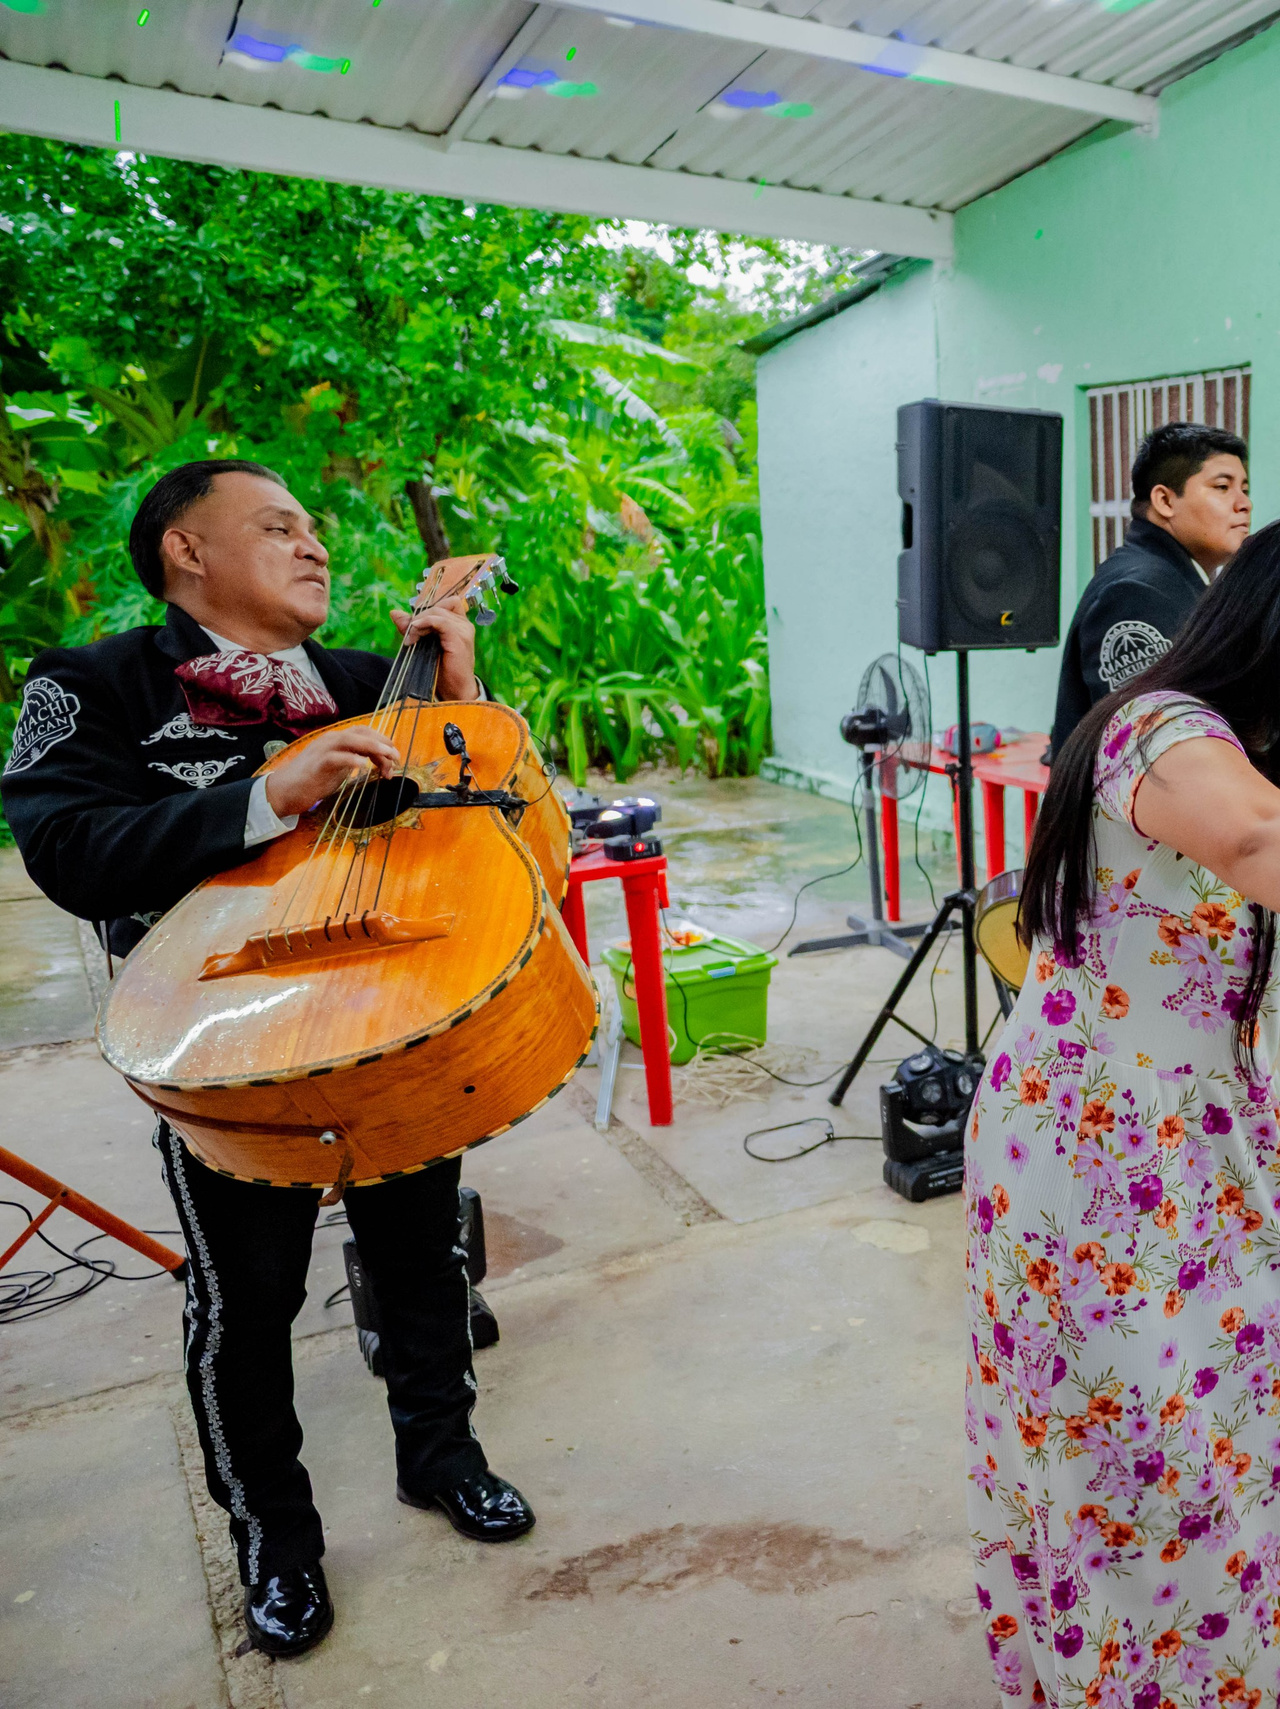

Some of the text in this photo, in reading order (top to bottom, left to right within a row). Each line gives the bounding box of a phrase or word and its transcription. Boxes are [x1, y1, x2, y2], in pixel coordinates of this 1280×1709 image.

[1103, 642, 1168, 676] MARIACHI
[1112, 656, 1162, 687] KUKULCA
[17, 698, 70, 741] RIACHI
